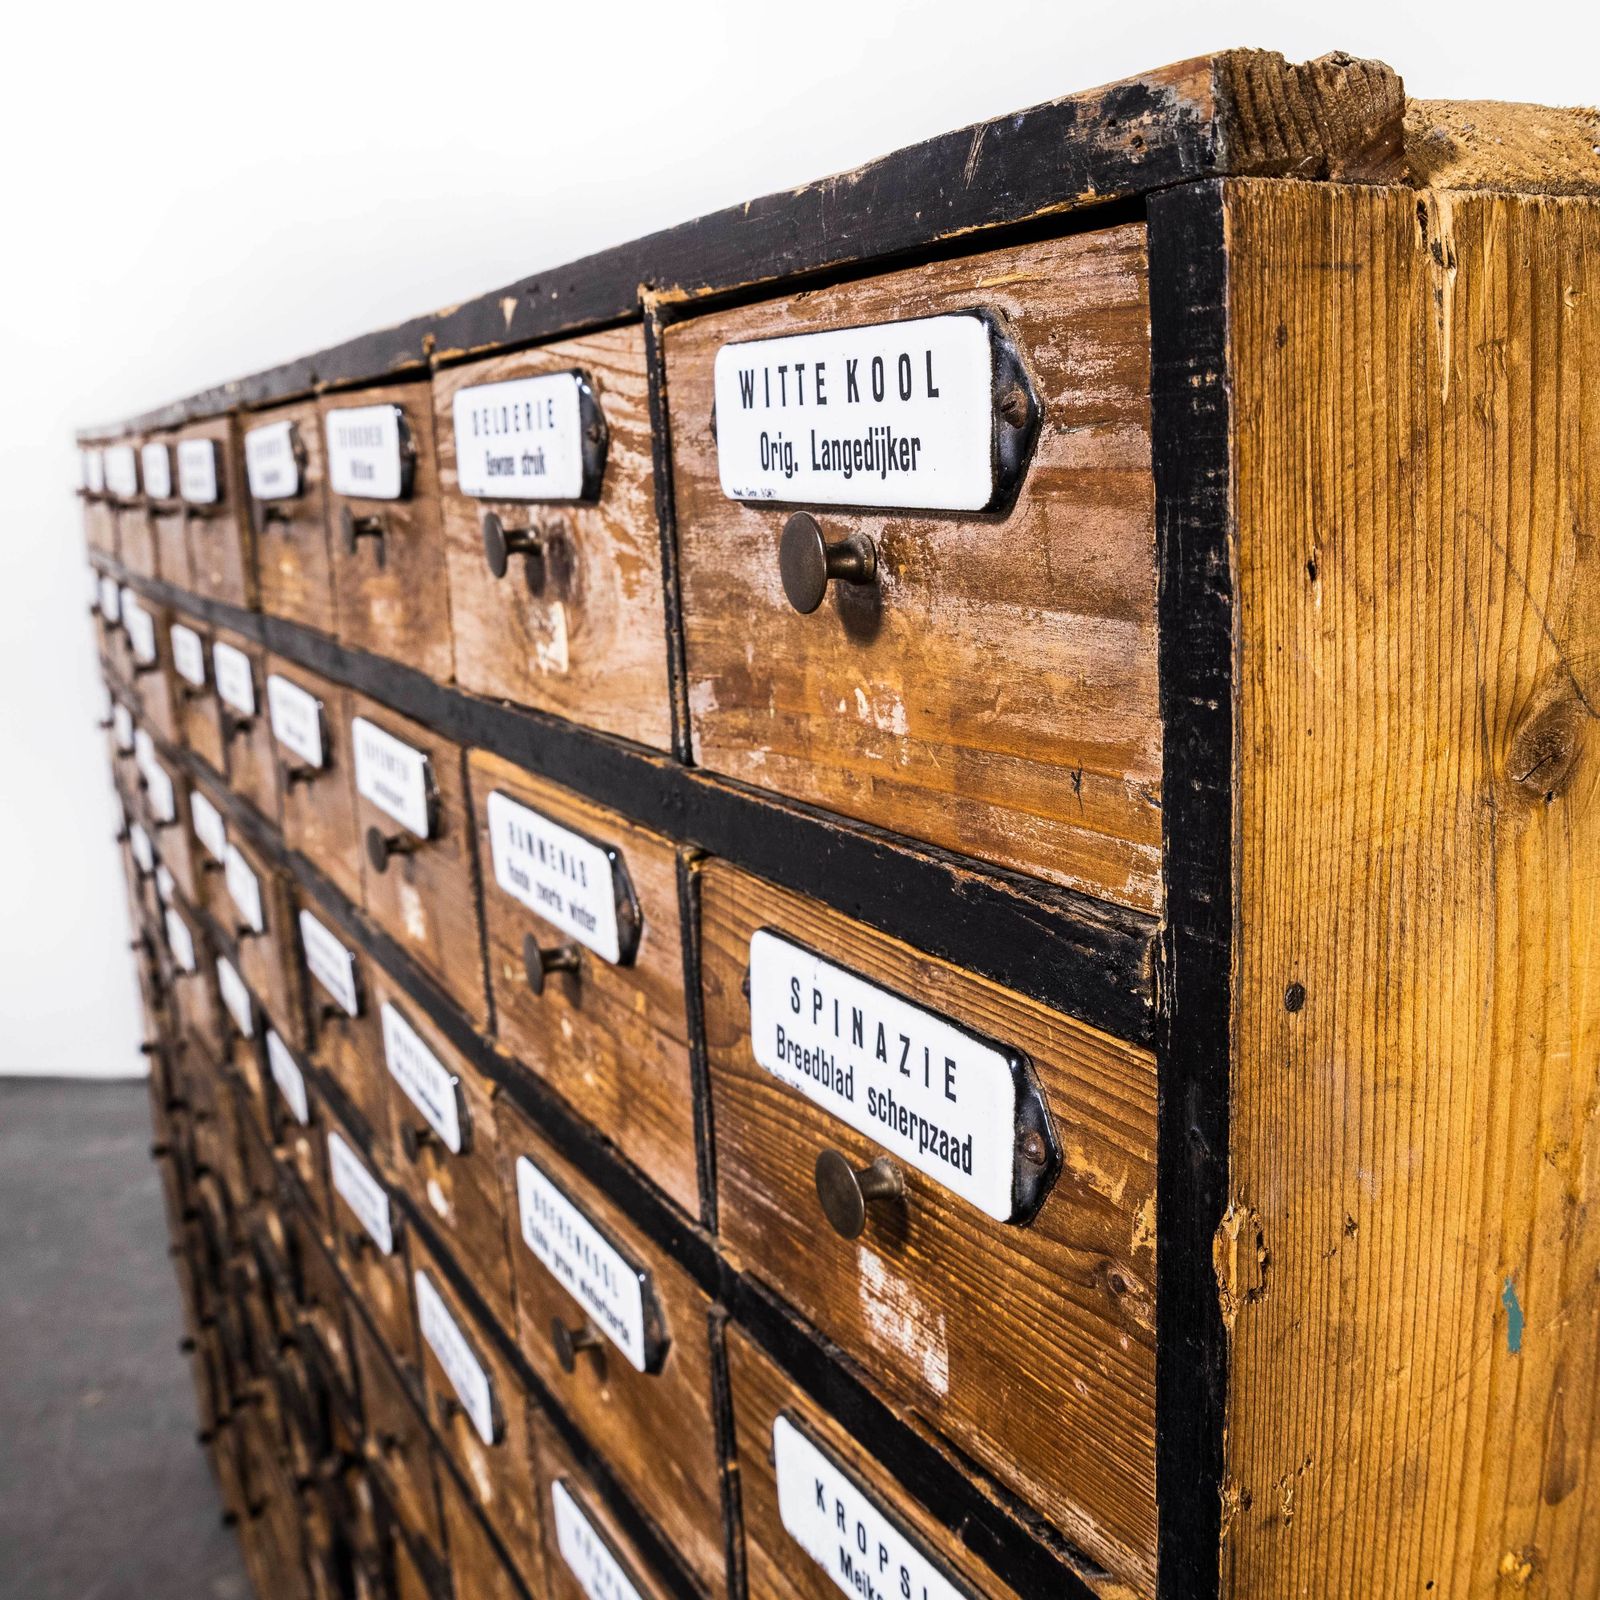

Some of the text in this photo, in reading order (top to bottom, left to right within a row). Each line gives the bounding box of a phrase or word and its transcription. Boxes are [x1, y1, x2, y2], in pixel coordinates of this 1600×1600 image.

[738, 350, 940, 409] WITTE KOOL
[760, 426, 921, 480] Orig. Langedijker
[790, 976, 957, 1103] SPINAZIE
[776, 1024, 973, 1176] Breedblad scherpzaad
